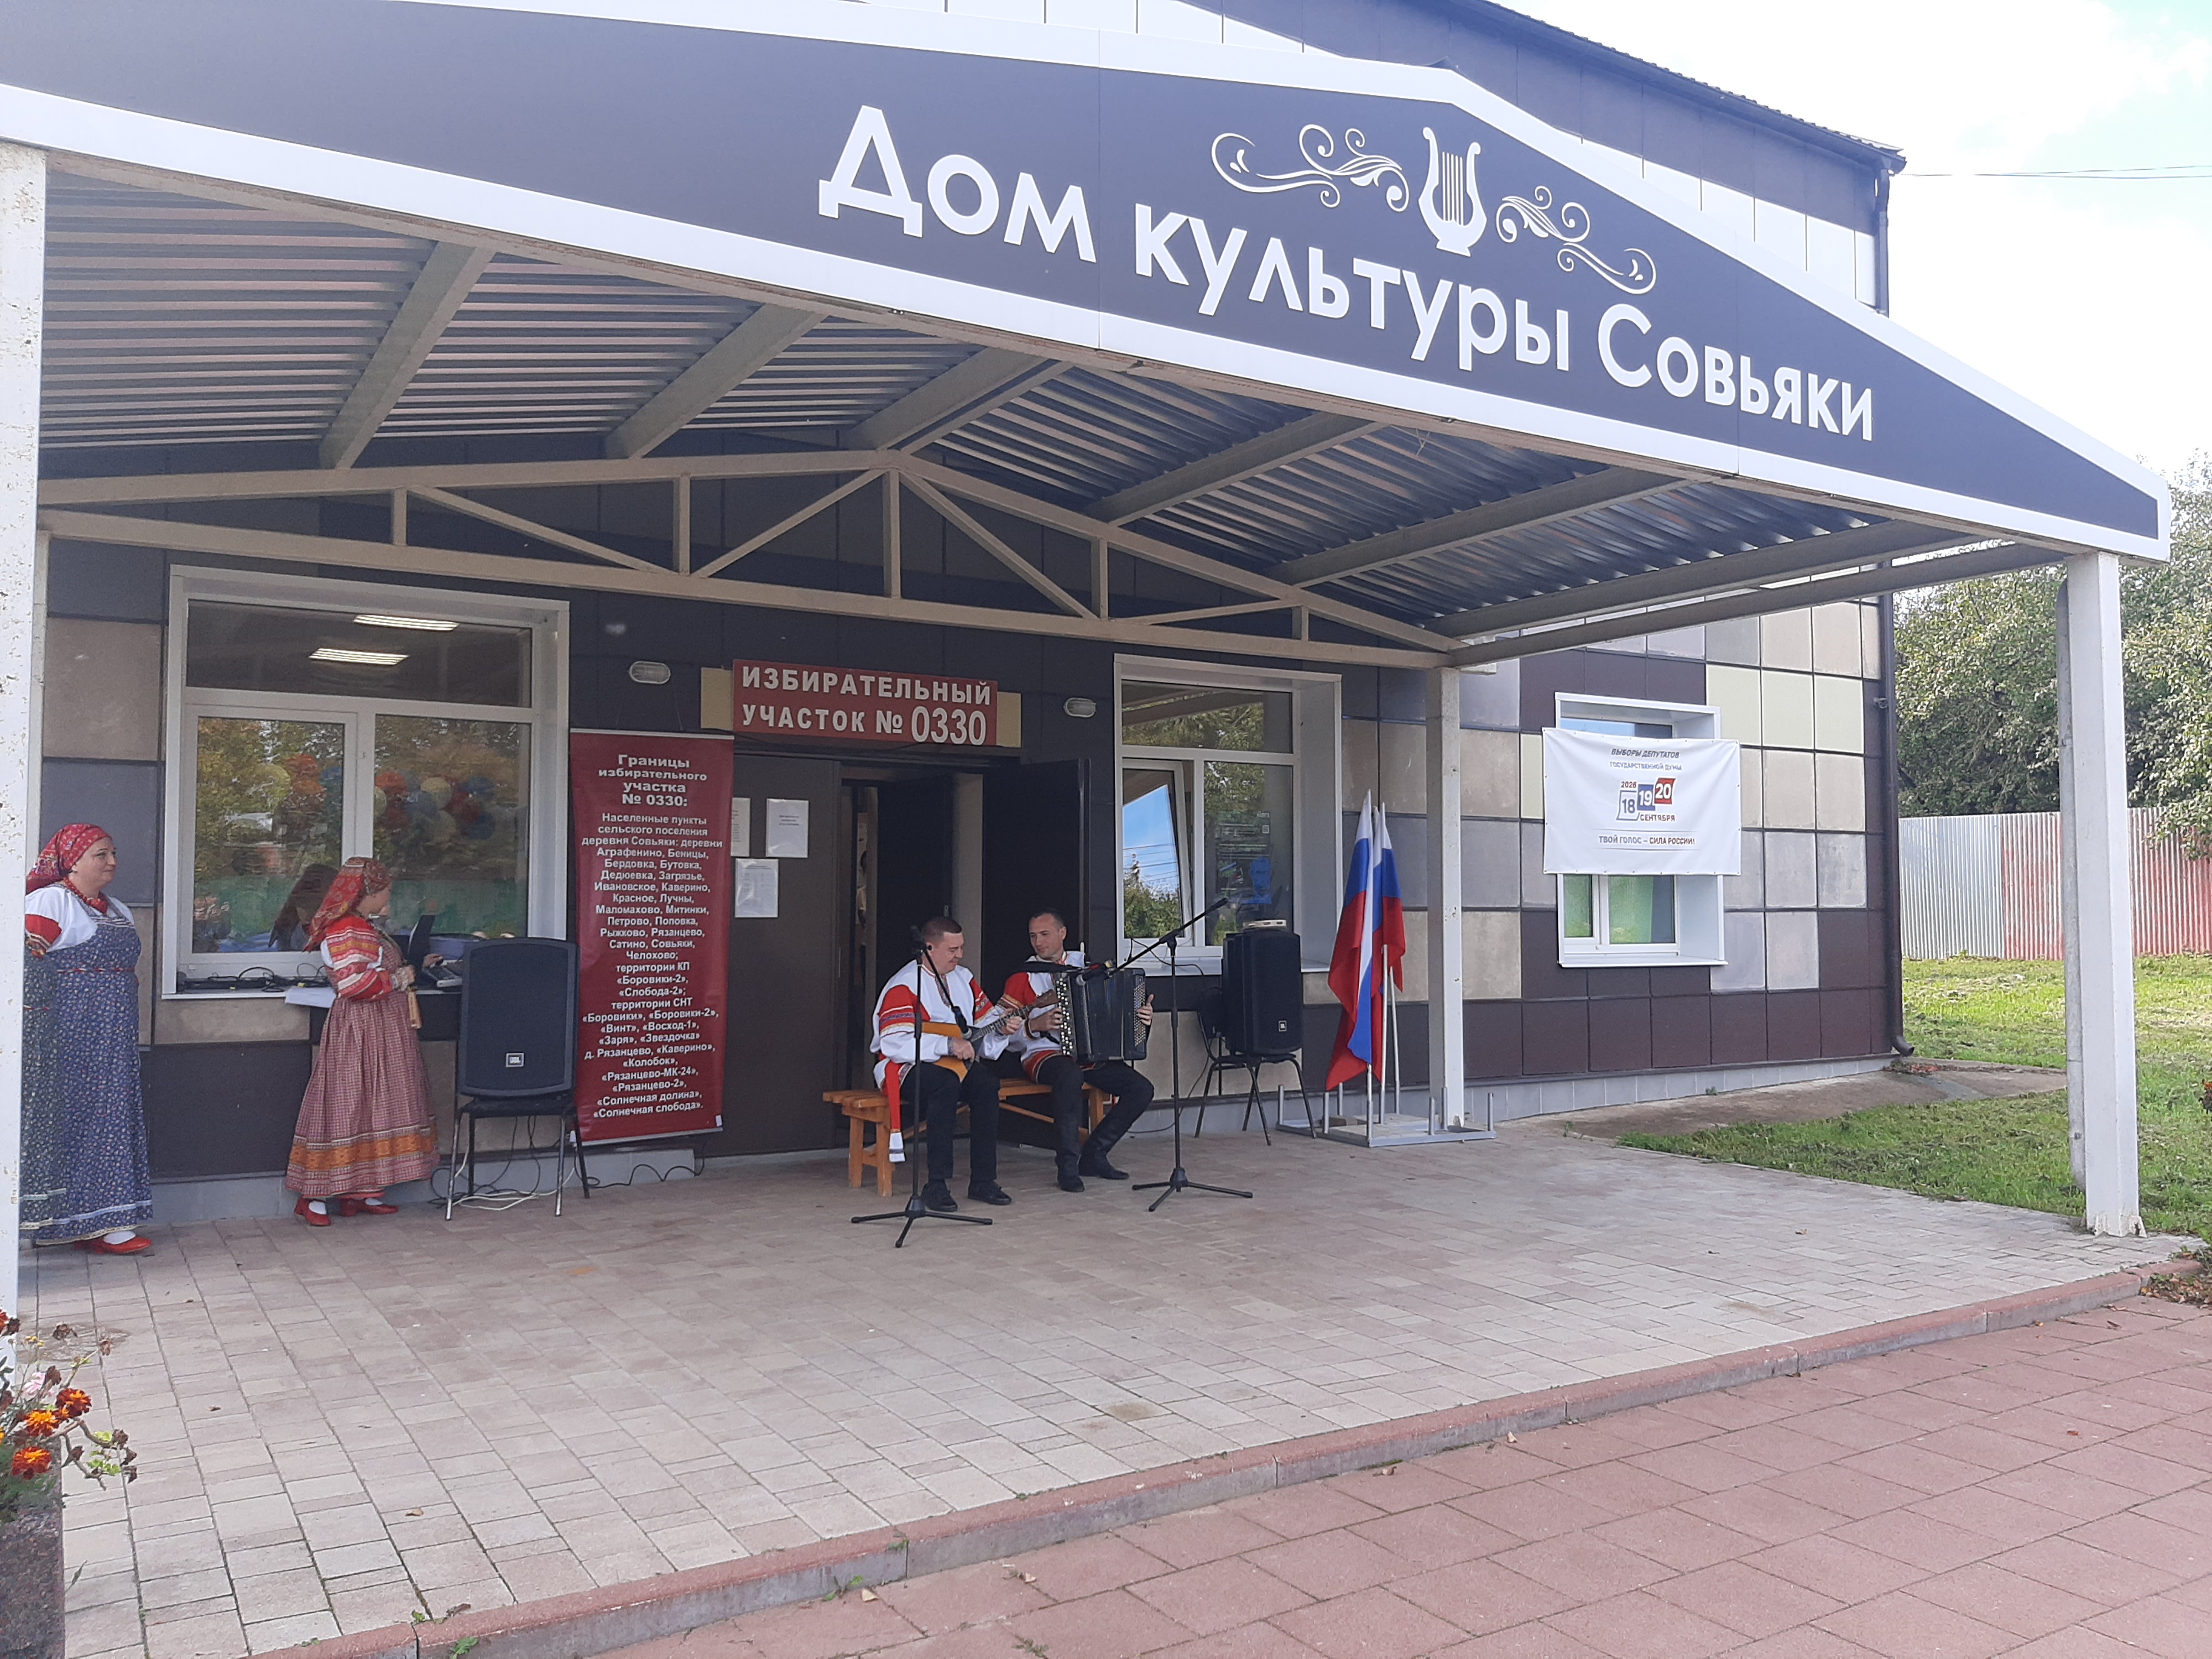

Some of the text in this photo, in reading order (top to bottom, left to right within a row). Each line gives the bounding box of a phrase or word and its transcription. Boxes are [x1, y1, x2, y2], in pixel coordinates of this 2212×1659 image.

[817, 105, 1874, 442] Дом культуры Совьяки
[742, 666, 990, 705] ИЗБИРАТЕЛЬНЫЙ
[742, 704, 987, 745] УЧАСТОК № 0330
[1611, 748, 1641, 757] ВЫБОРЫ
[618, 754, 690, 768] Границы
[599, 768, 707, 781] избирательного
[623, 782, 685, 792] участка
[1655, 783, 1671, 799] 20
[622, 794, 687, 806] № 0330:
[1639, 790, 1652, 806] 19
[1621, 799, 1635, 813] 18
[602, 813, 706, 826] Населенные пункты
[598, 826, 707, 836] сельского поселения
[582, 836, 723, 848] деревня Совьяки: деревни
[1599, 834, 1618, 843] ТВОЙ
[605, 859, 702, 869] Бердовка, Бутовка,
[601, 870, 655, 880] Дедюевка,
[594, 882, 710, 893] Ивановское, Каверино,
[613, 894, 694, 904] Красное, Лучны,
[666, 905, 709, 915] Митинки,
[608, 917, 698, 927] Петрово, Поповка,
[601, 928, 705, 937] Рыжково, Рязанцево,
[609, 939, 695, 949] Сатино, Совьяки,
[617, 962, 690, 973] территории КП
[612, 997, 692, 1010] территории СНТ
[597, 1047, 654, 1057] Рязанцево,
